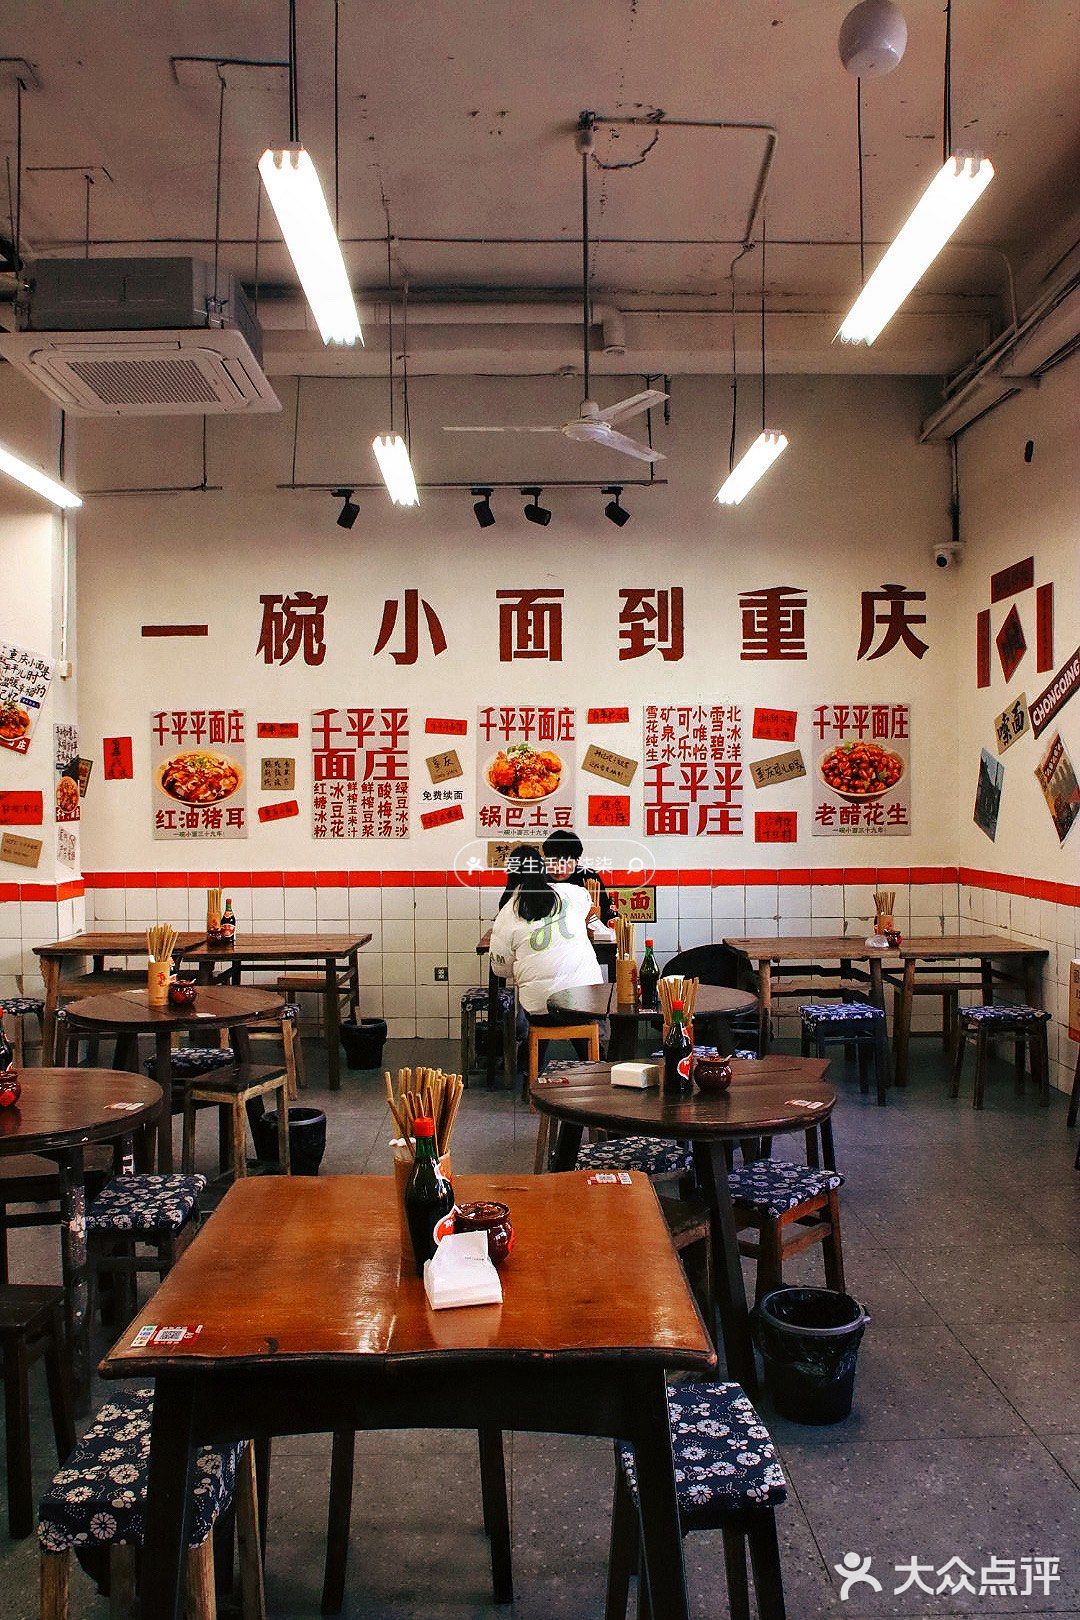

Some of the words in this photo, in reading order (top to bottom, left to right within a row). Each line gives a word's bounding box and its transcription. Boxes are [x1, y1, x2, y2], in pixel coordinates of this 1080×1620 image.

[142, 584, 930, 666] 一碗小面到重庆
[152, 709, 245, 746] 千平平面庄
[311, 708, 409, 749] 千平平
[479, 706, 575, 742] 千平平面庄
[645, 705, 658, 762] 雪花纯生
[659, 705, 676, 762] 矿泉水
[677, 707, 692, 762] 可乐
[692, 705, 707, 762] 小唯怡
[710, 705, 725, 761] 雪碧
[726, 705, 741, 762] 北冰洋
[813, 704, 909, 740] 千平平面庄
[311, 748, 409, 781] 面庄
[644, 762, 743, 803] 千平平
[155, 807, 245, 830] 红油猪耳
[313, 782, 327, 838] 红糖冰粉
[330, 782, 344, 838] 冰豆花
[347, 781, 358, 838] 鲜榨玉米汁
[361, 781, 375, 838] 鲜榨豆浆
[377, 781, 392, 838] 酸梅汤
[395, 781, 409, 838] 绿豆冰沙
[422, 790, 463, 801] 免费续面
[479, 805, 574, 829] 锅巴土豆
[644, 801, 743, 837] 面庄
[814, 802, 909, 826] 老醋花生
